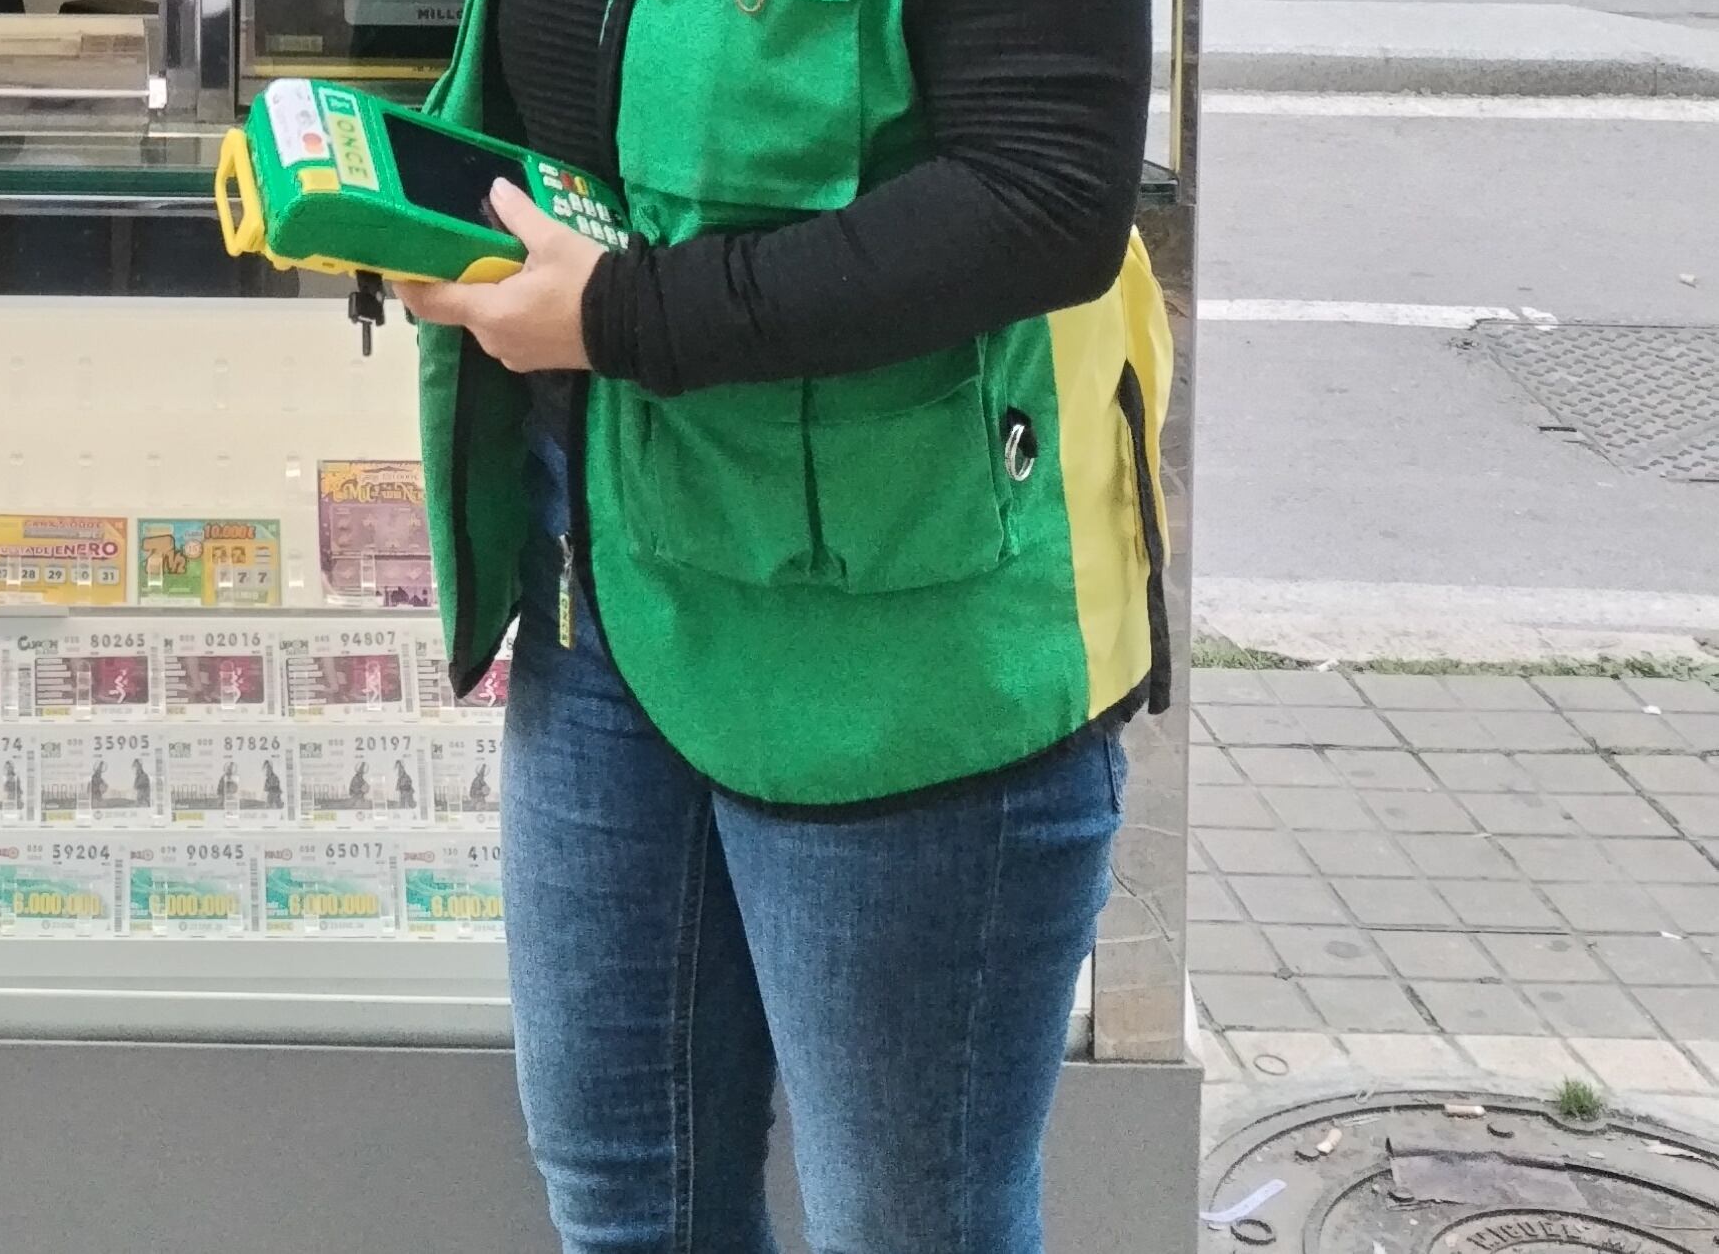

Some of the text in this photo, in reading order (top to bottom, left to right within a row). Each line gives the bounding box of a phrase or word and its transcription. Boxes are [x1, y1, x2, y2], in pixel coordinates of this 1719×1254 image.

[334, 118, 369, 179] ONCE
[55, 541, 119, 557] ENERO
[21, 569, 36, 579] 28
[48, 570, 62, 580] 29
[102, 571, 115, 581] 31
[90, 633, 145, 648] 80265
[204, 632, 261, 647] 02016
[340, 631, 396, 647] 94807
[93, 735, 150, 751] 35905
[223, 736, 281, 751] 87826
[354, 736, 411, 752] 20197
[52, 843, 111, 860] 59204
[186, 844, 244, 860] 90845
[325, 843, 383, 859] 65017
[467, 846, 501, 861] 410
